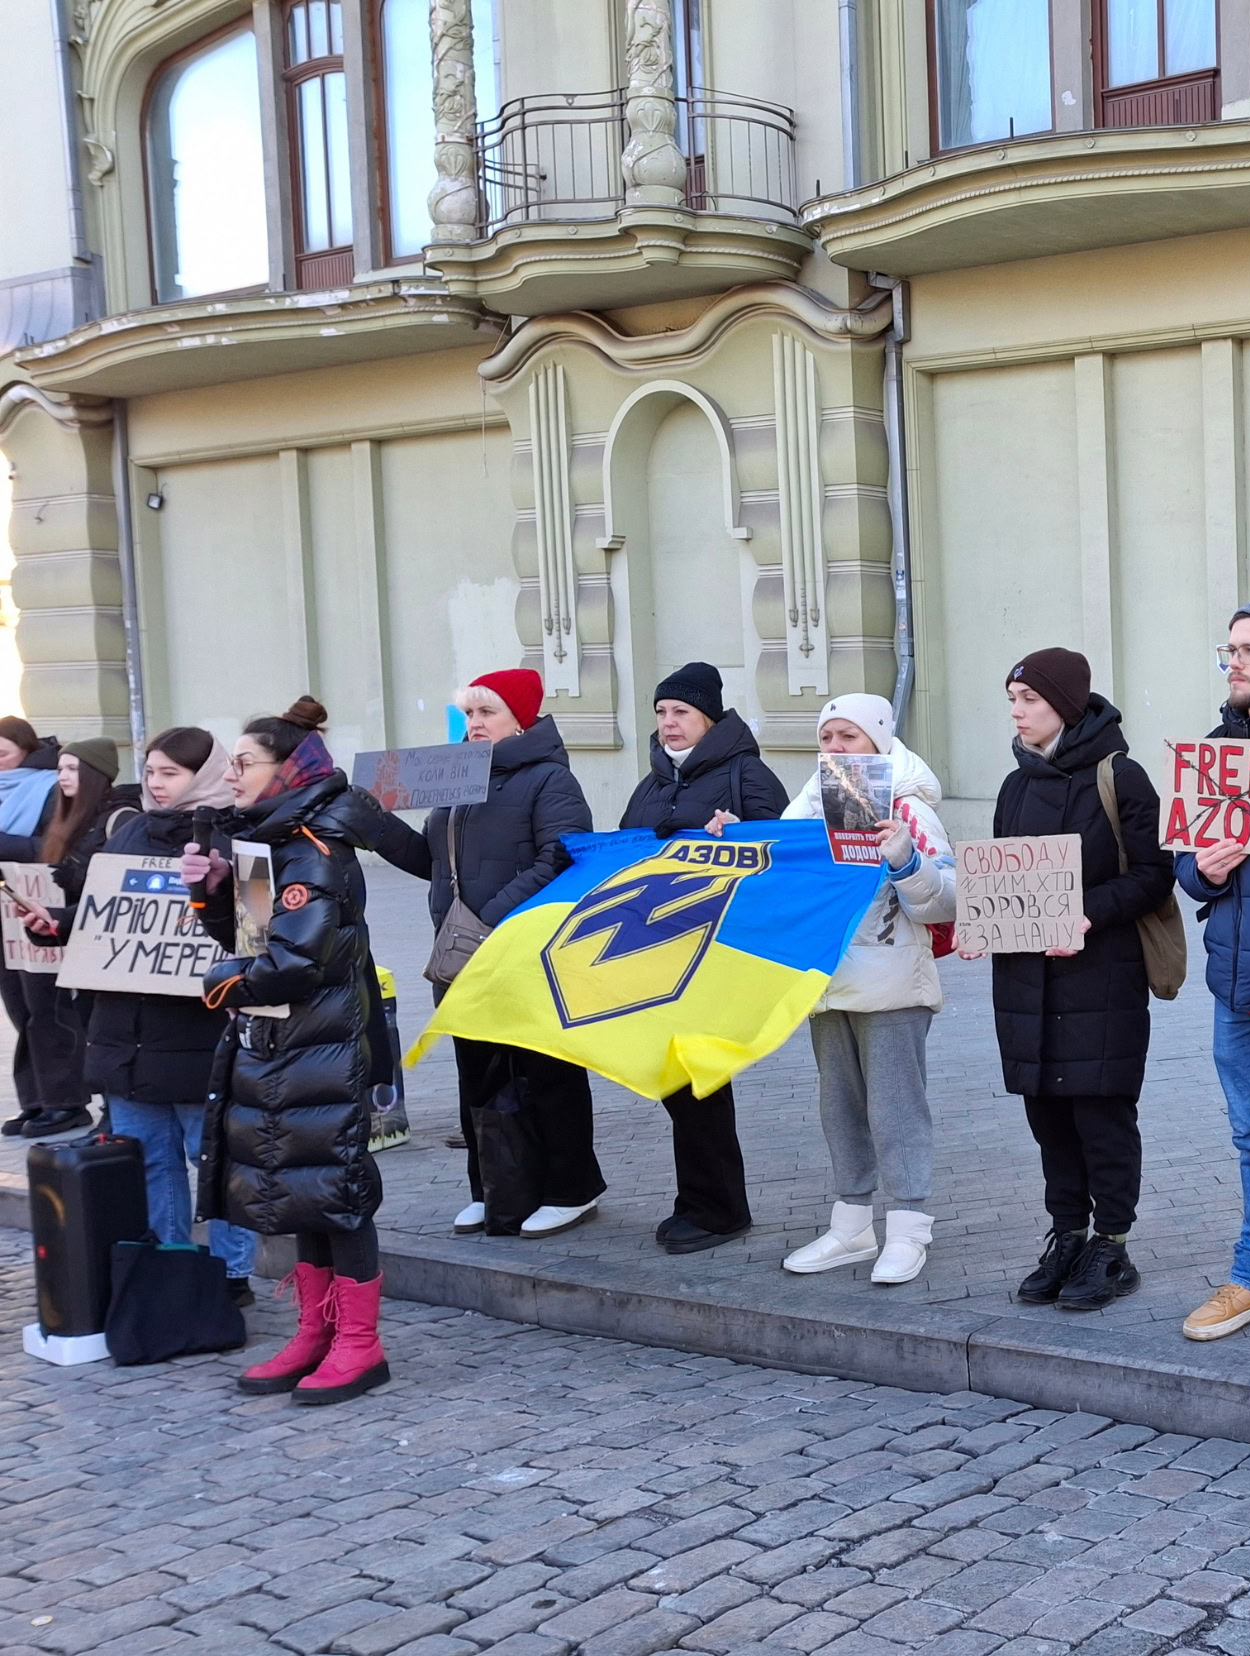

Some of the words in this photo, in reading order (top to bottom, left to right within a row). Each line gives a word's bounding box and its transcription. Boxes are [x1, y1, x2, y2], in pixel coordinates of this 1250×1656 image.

[450, 763, 469, 780] ВІН
[141, 857, 172, 869] FREE
[669, 844, 760, 869] АЗОВ
[963, 841, 1069, 875] СВОБОДУ
[1037, 871, 1075, 893] ХТО
[966, 893, 1071, 921] БОРОВСЯ
[976, 924, 1004, 952] ЗА
[1013, 921, 1075, 949] НАШУ
